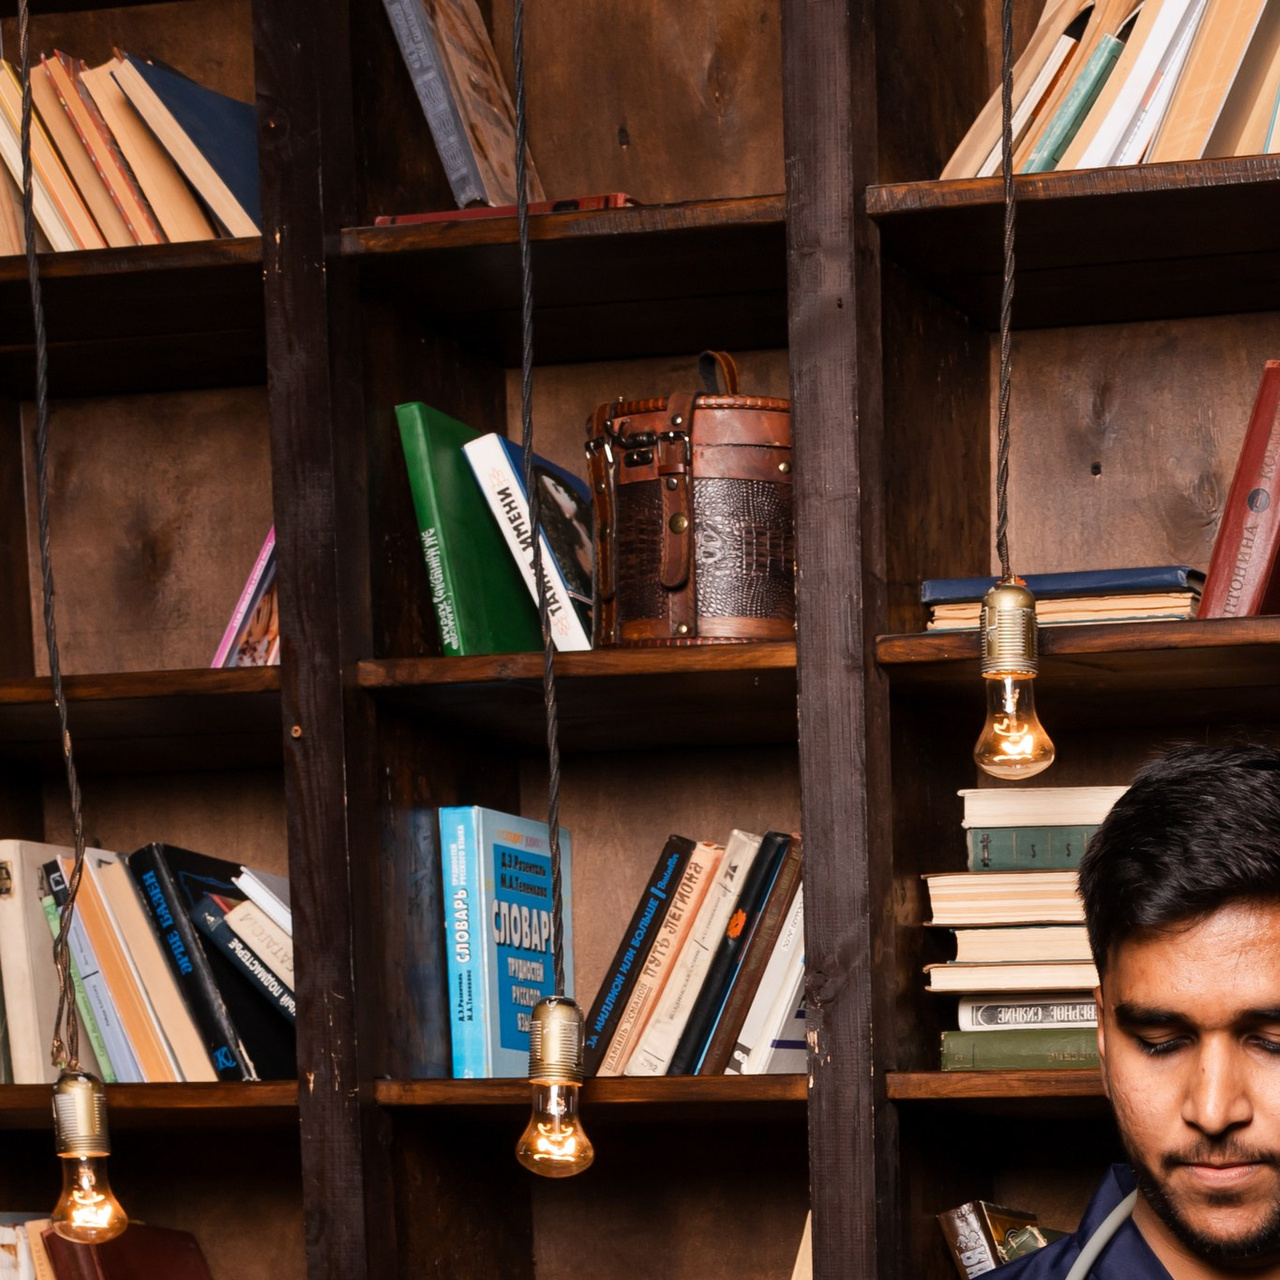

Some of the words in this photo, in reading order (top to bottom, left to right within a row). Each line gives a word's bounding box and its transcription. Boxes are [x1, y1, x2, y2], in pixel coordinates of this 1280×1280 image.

[496, 485, 535, 552] ИМЕНИ
[140, 869, 174, 927] БАЗЕН
[453, 888, 471, 963] СЛОВАРЬ
[227, 936, 284, 997] ПОДМАСТЕРЬЕ
[507, 957, 545, 983] ТРУДНОСТЕЙ
[592, 973, 626, 1033] МИЛЛИОН
[618, 947, 638, 974] ИЛИ
[630, 896, 660, 949] БОЛЬШЕ
[638, 934, 672, 980] ПУТЬ
[602, 1026, 630, 1071] ШАМИЛЬ
[621, 981, 650, 1027] УСМАНОВ
[997, 1006, 1042, 1023] СИЯНИЕ
